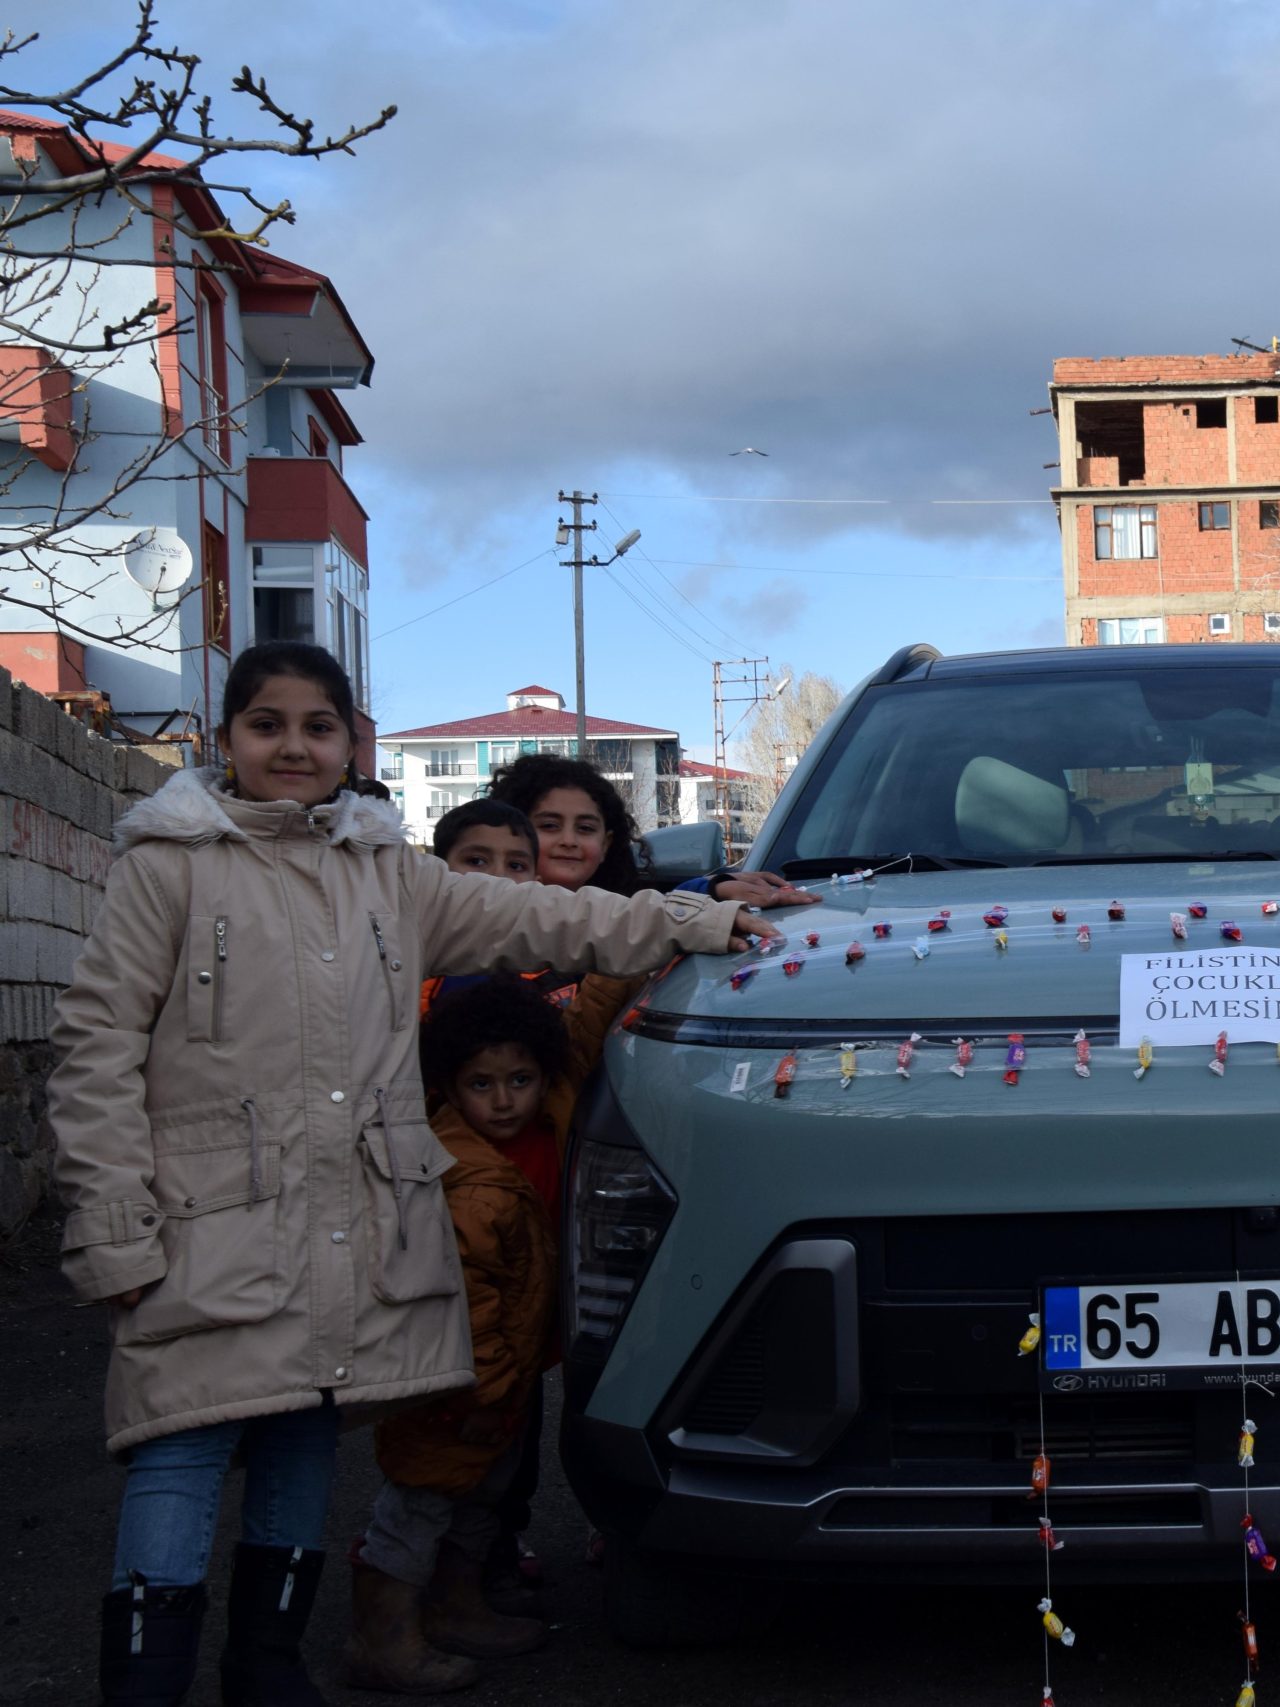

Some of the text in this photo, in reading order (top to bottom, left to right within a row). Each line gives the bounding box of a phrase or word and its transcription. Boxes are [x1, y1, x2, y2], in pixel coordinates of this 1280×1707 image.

[1085, 1292, 1160, 1359] 65
[1050, 1335, 1077, 1353] TR
[1088, 1373, 1166, 1388] HYUNDAI
